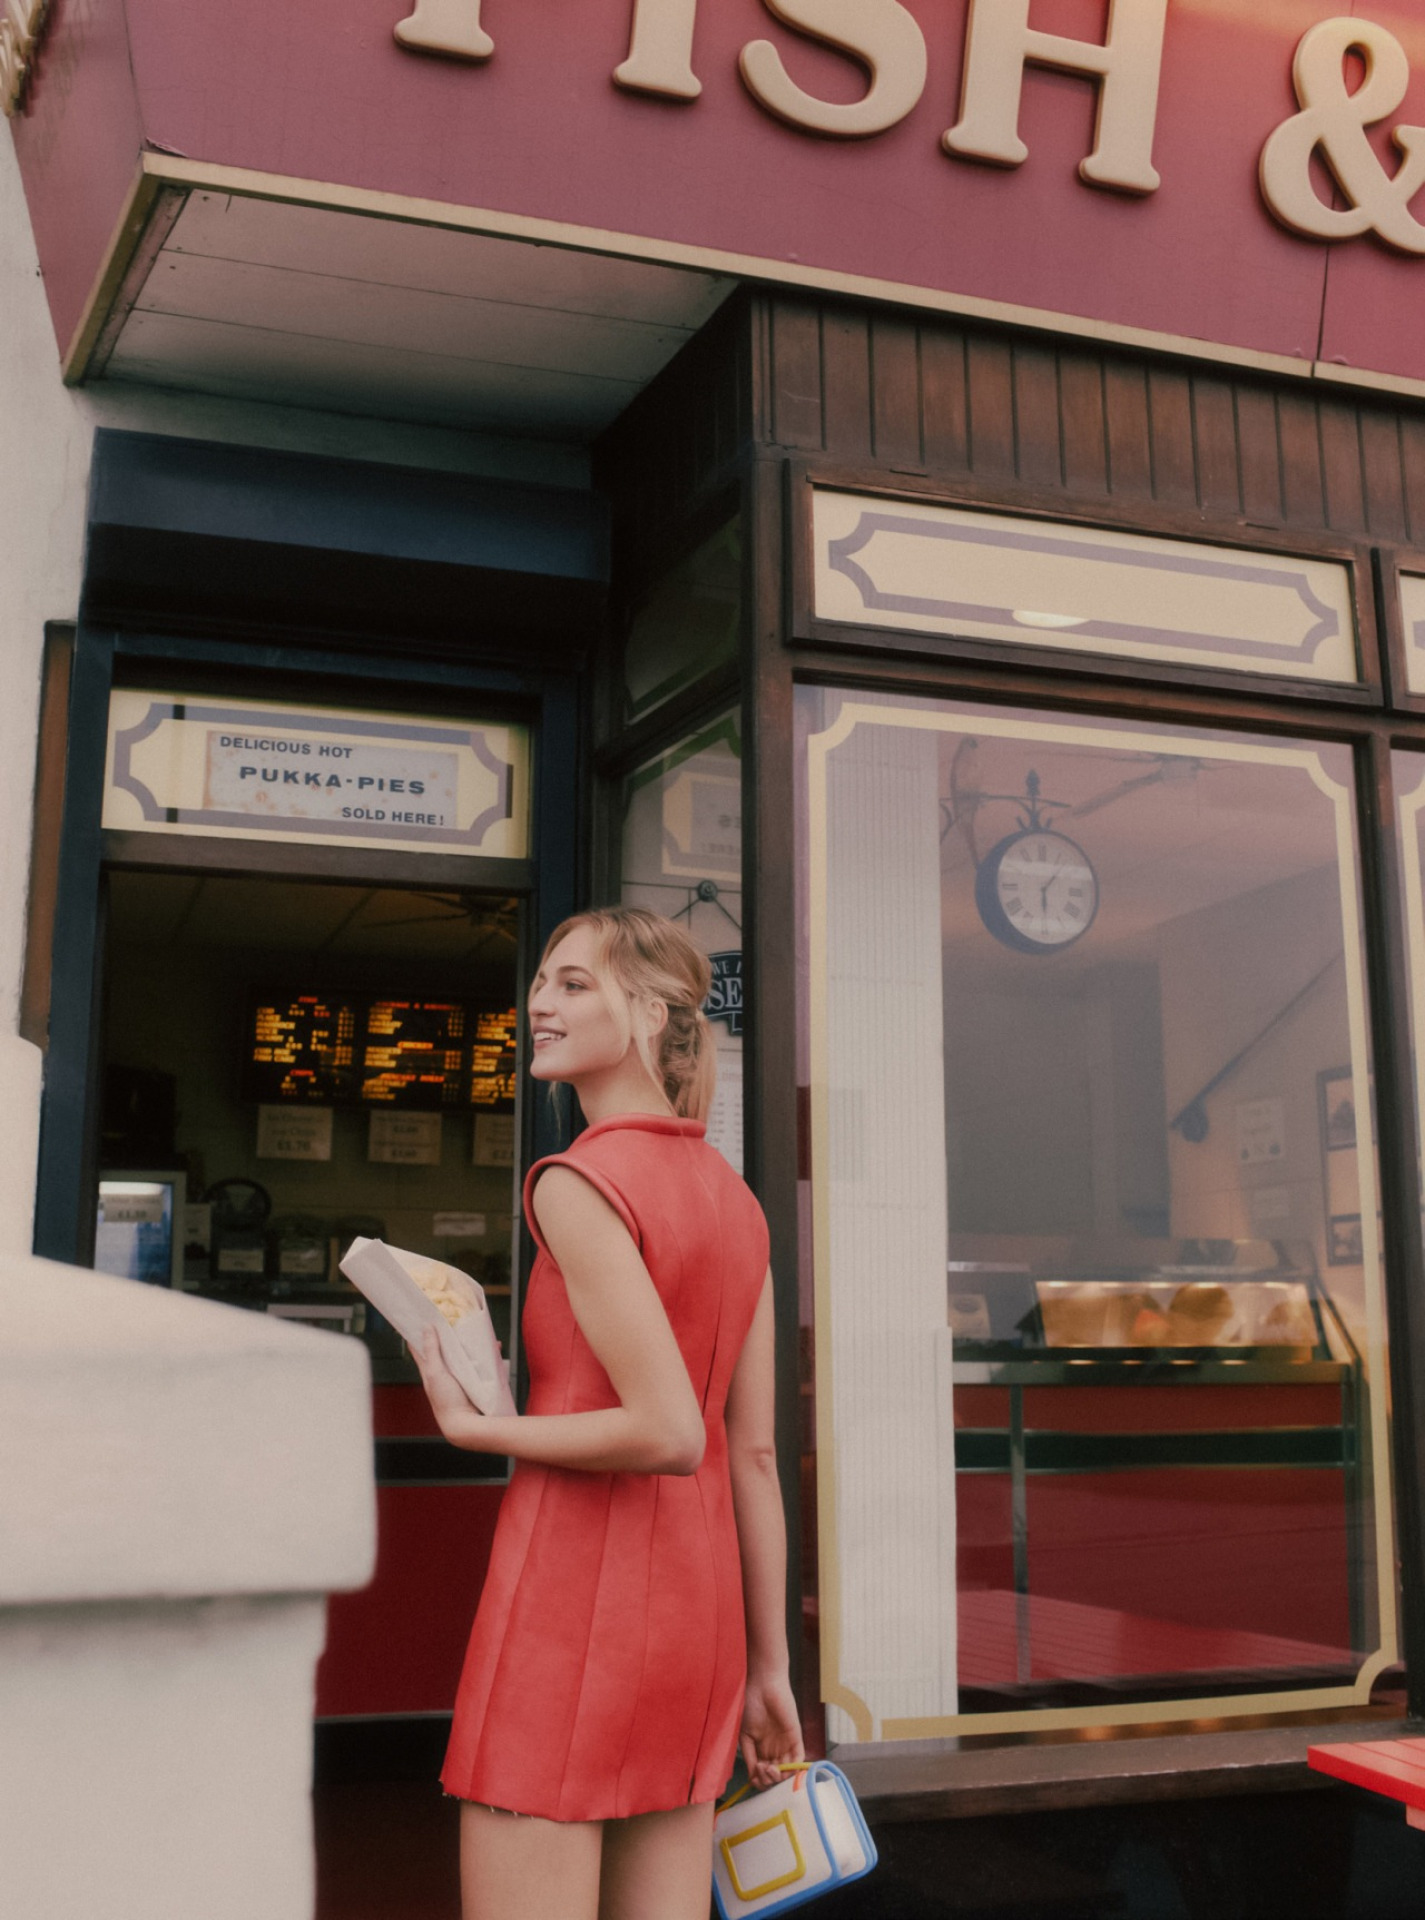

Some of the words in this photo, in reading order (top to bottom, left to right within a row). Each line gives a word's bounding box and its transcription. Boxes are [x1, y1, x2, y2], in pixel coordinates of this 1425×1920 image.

[393, 0, 1162, 196] SH
[1260, 16, 1425, 256] &
[220, 736, 311, 755] DELICIOUS
[319, 745, 353, 759] HOT
[239, 766, 426, 795] PUKKA-PIES
[342, 806, 386, 821] SOLD
[391, 810, 445, 826] HERE!
